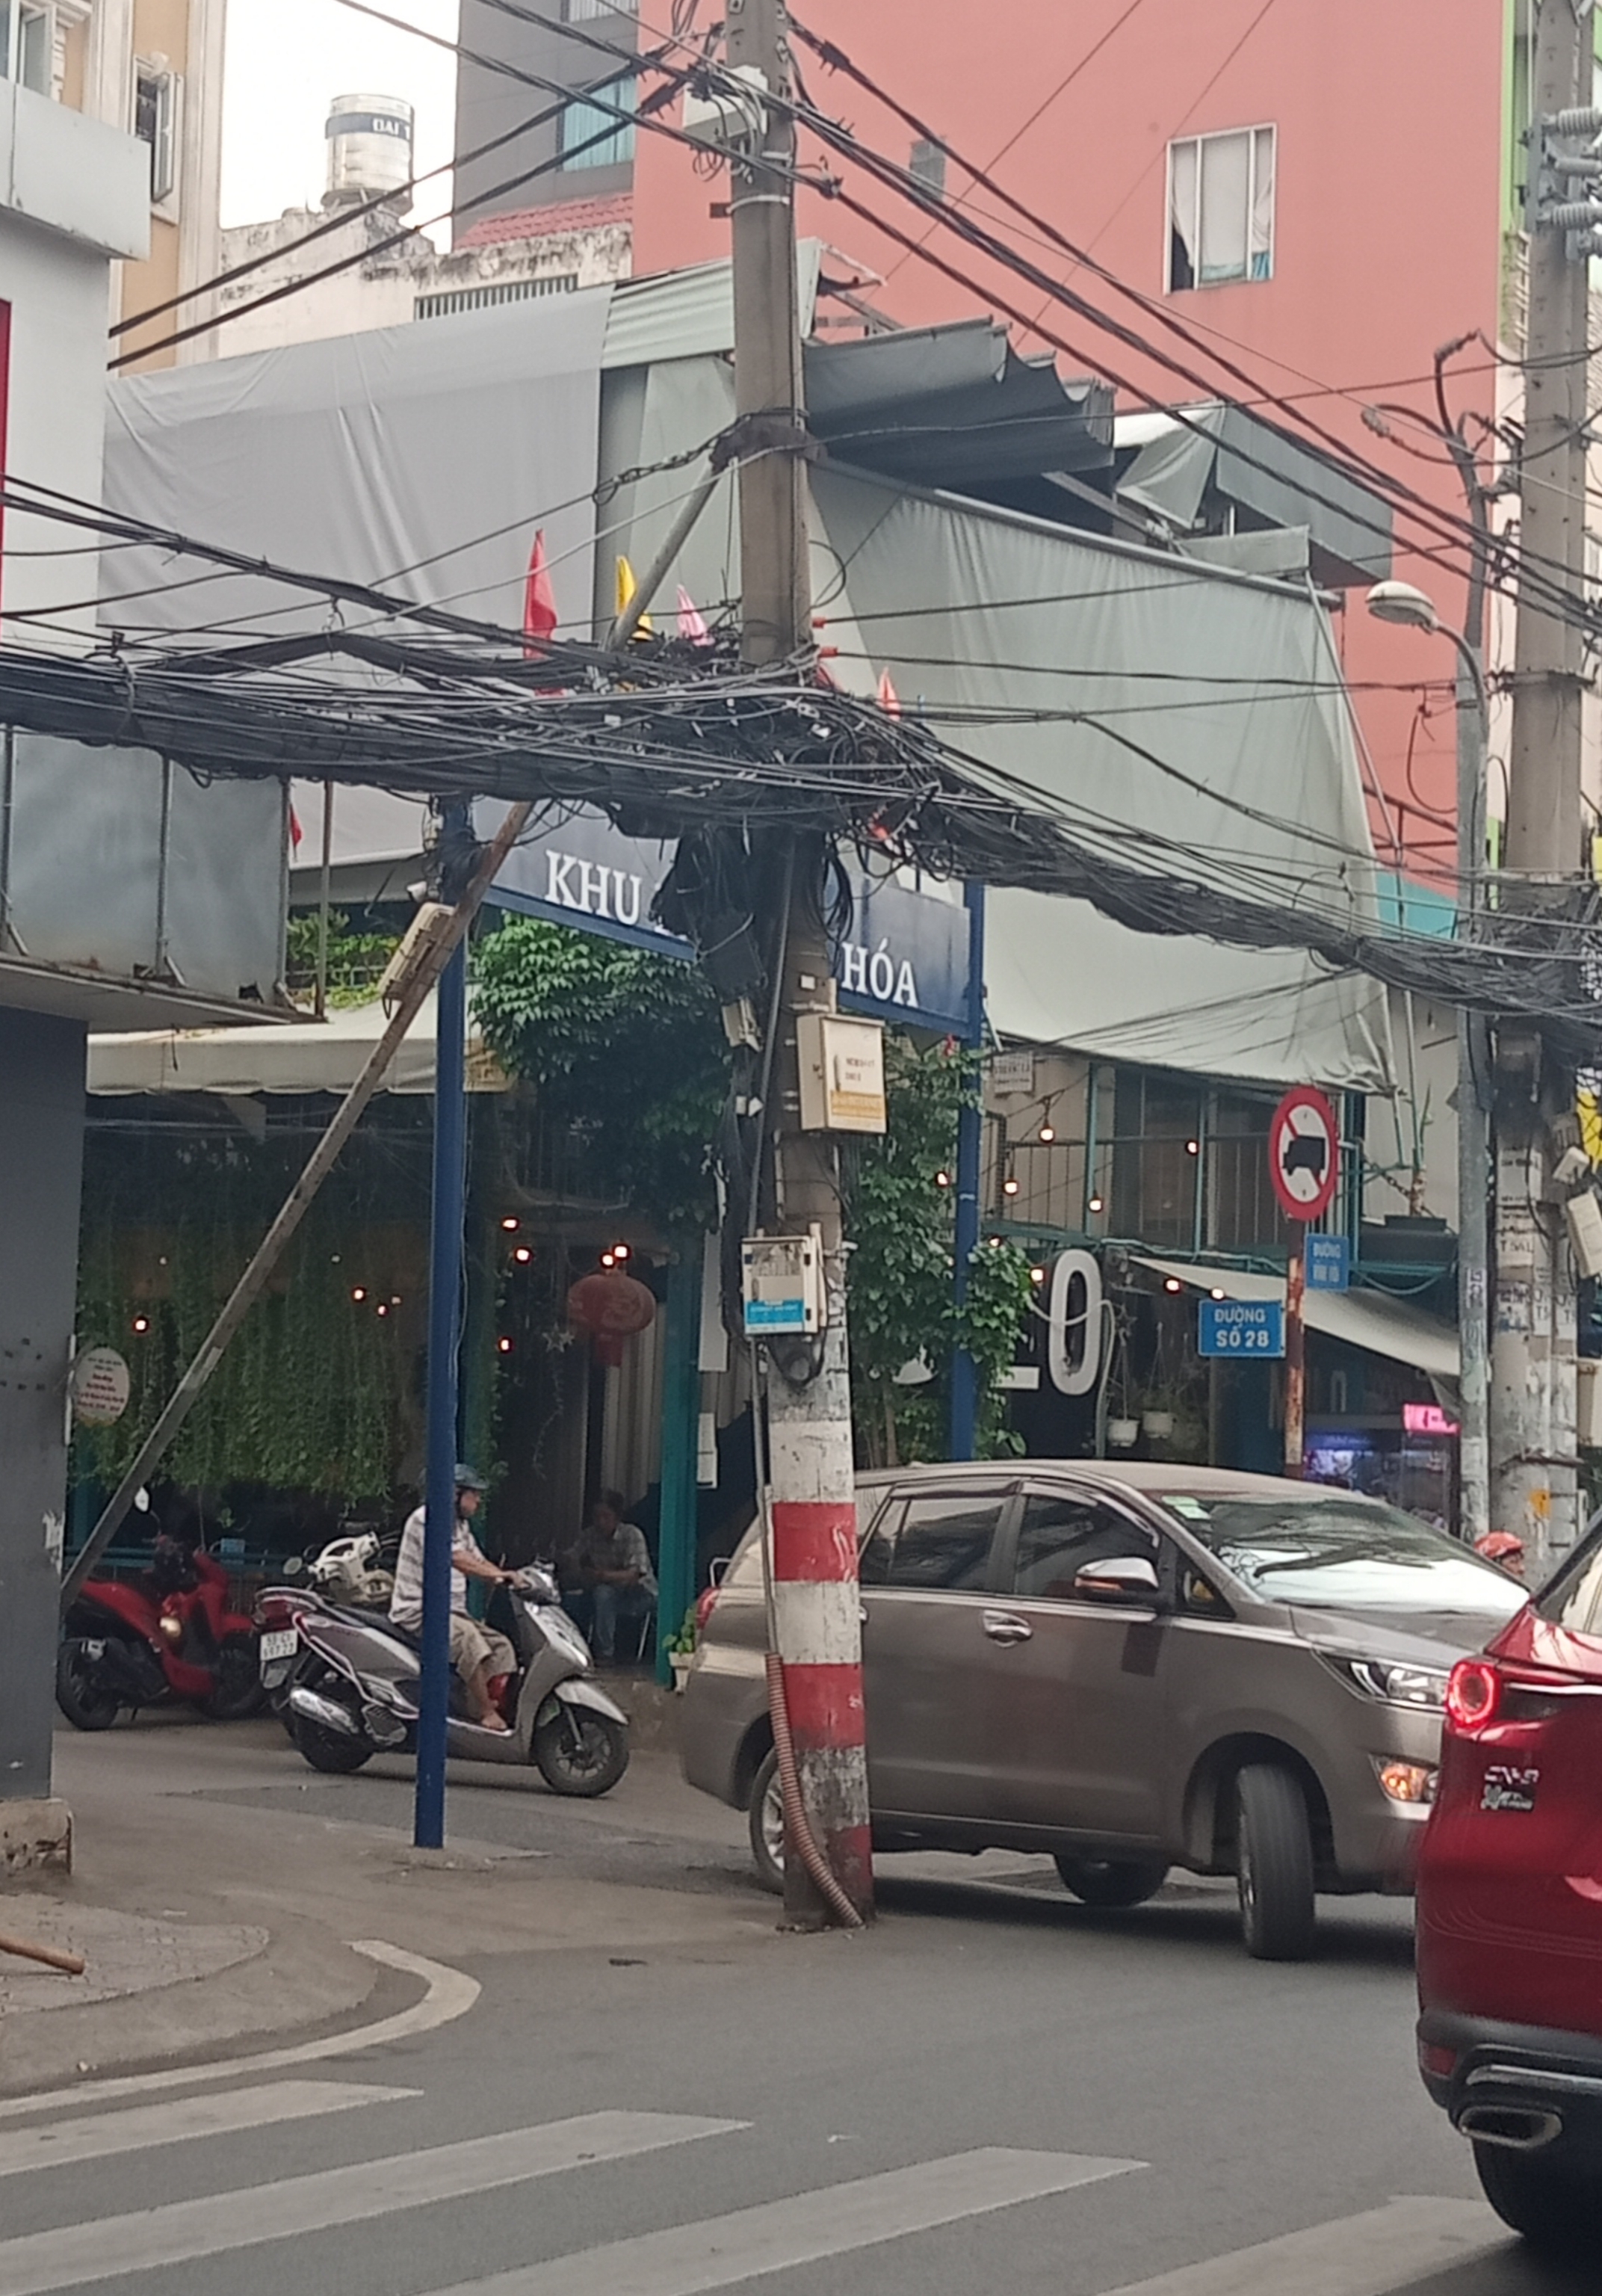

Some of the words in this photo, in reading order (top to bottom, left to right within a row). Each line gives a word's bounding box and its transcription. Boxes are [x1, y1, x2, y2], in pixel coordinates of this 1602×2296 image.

[545, 849, 642, 926] KHU
[841, 937, 919, 1008] HÓA
[1213, 1305, 1267, 1324] ĐƯỜNG
[1216, 1324, 1243, 1348] SỐ
[1245, 1330, 1269, 1348] 28
